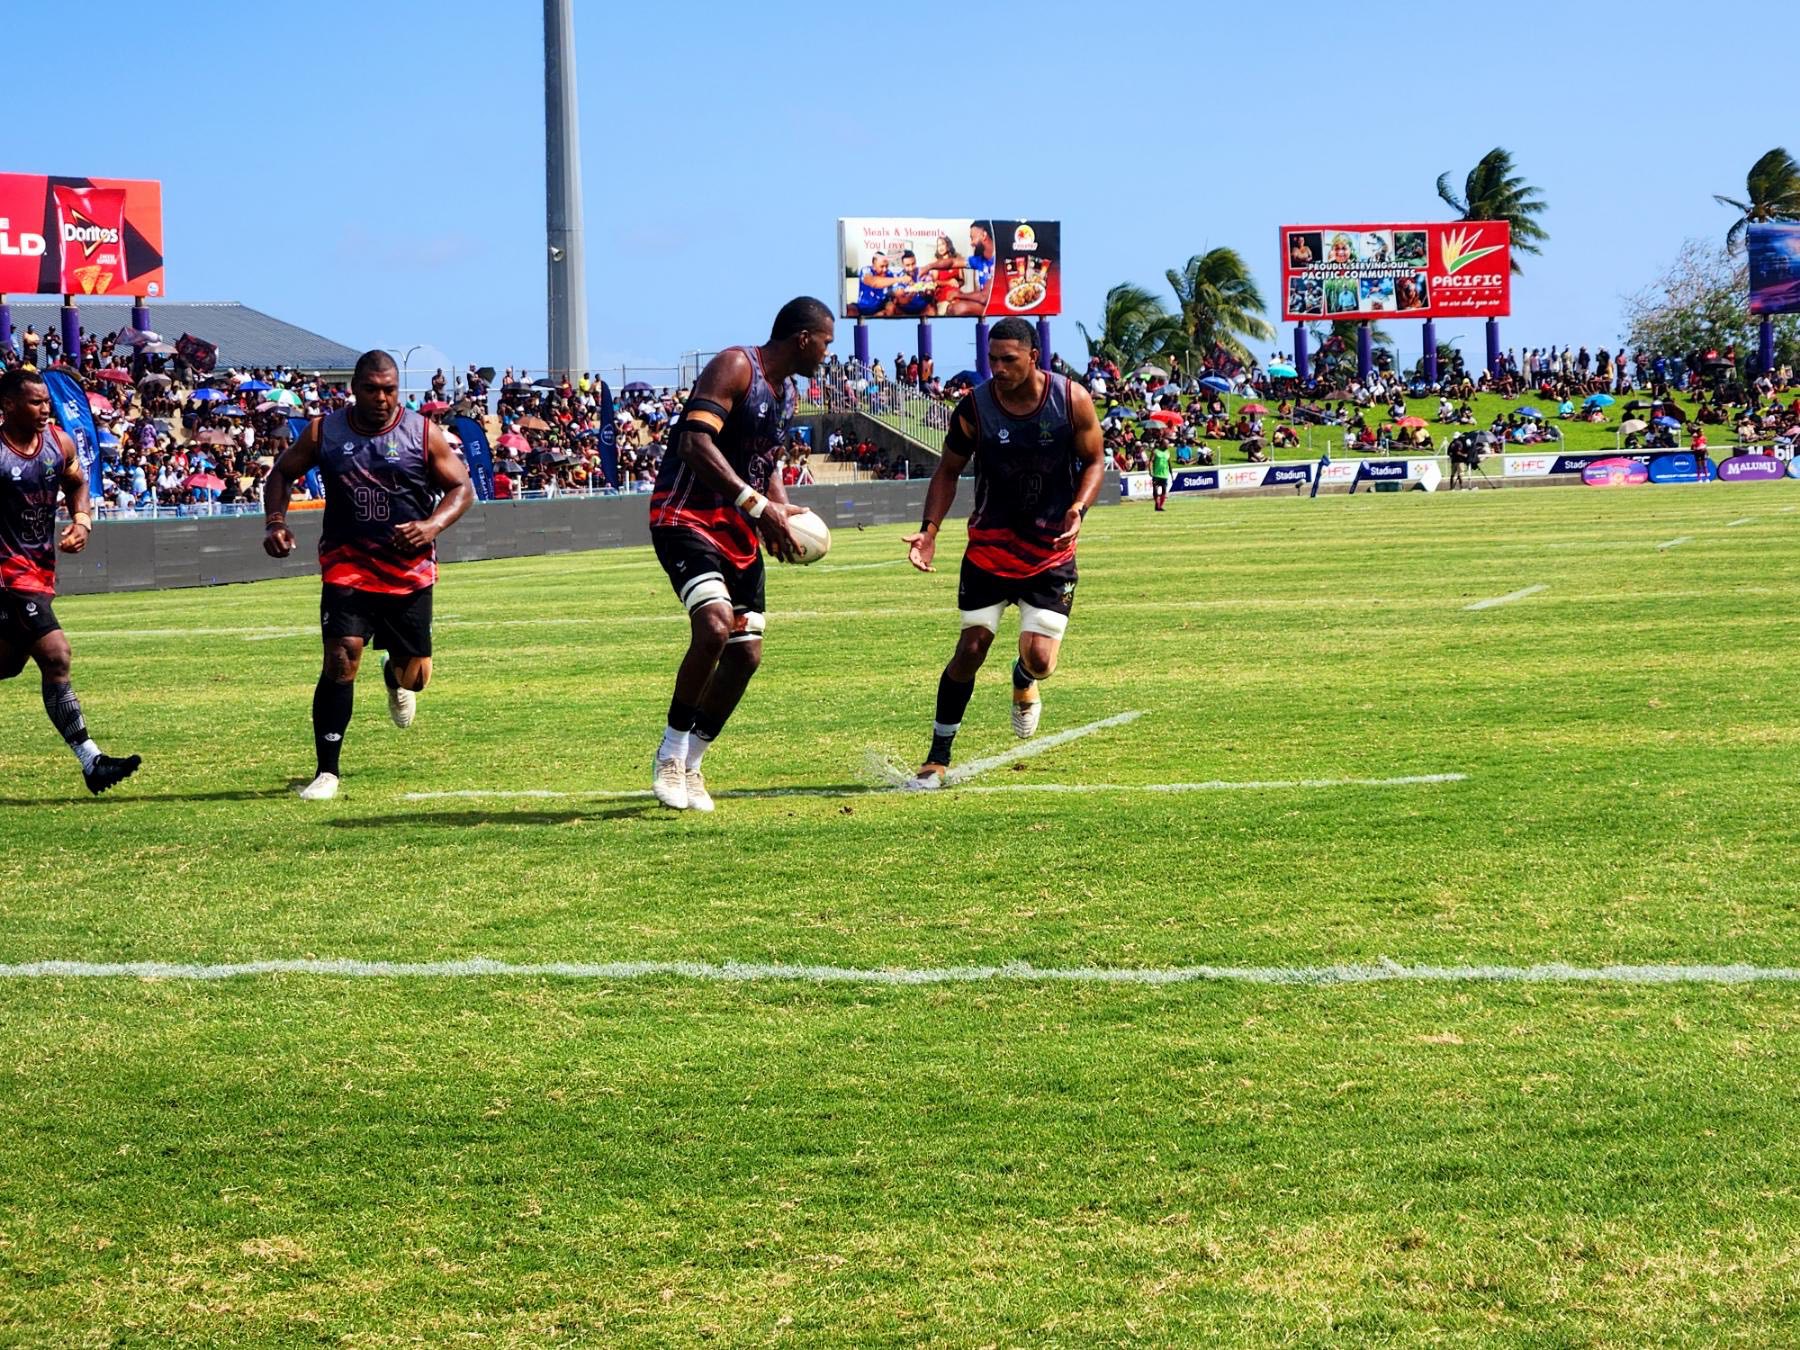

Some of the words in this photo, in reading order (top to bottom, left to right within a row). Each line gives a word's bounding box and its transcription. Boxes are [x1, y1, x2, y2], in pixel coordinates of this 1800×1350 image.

[64, 223, 119, 243] Doritos
[863, 227, 890, 237] Meals
[904, 227, 945, 237] Moments
[864, 240, 880, 249] You
[883, 239, 905, 249] Love
[1308, 263, 1347, 271] PROUDLY
[1350, 262, 1387, 270] SERVING
[1390, 261, 1409, 269] OUR
[1302, 271, 1340, 280] PACIFIC
[1344, 269, 1416, 279] COMMUNITIES
[1432, 274, 1503, 287] PACIFIC
[1183, 475, 1214, 486] Stadium
[1235, 472, 1257, 481] HFC
[1275, 469, 1306, 480] Stadium
[1328, 466, 1350, 475] HFC
[1371, 465, 1402, 476] Stadium
[1522, 460, 1545, 469] HFC
[1727, 461, 1777, 475] MALUMU
[354, 486, 390, 522] 98
